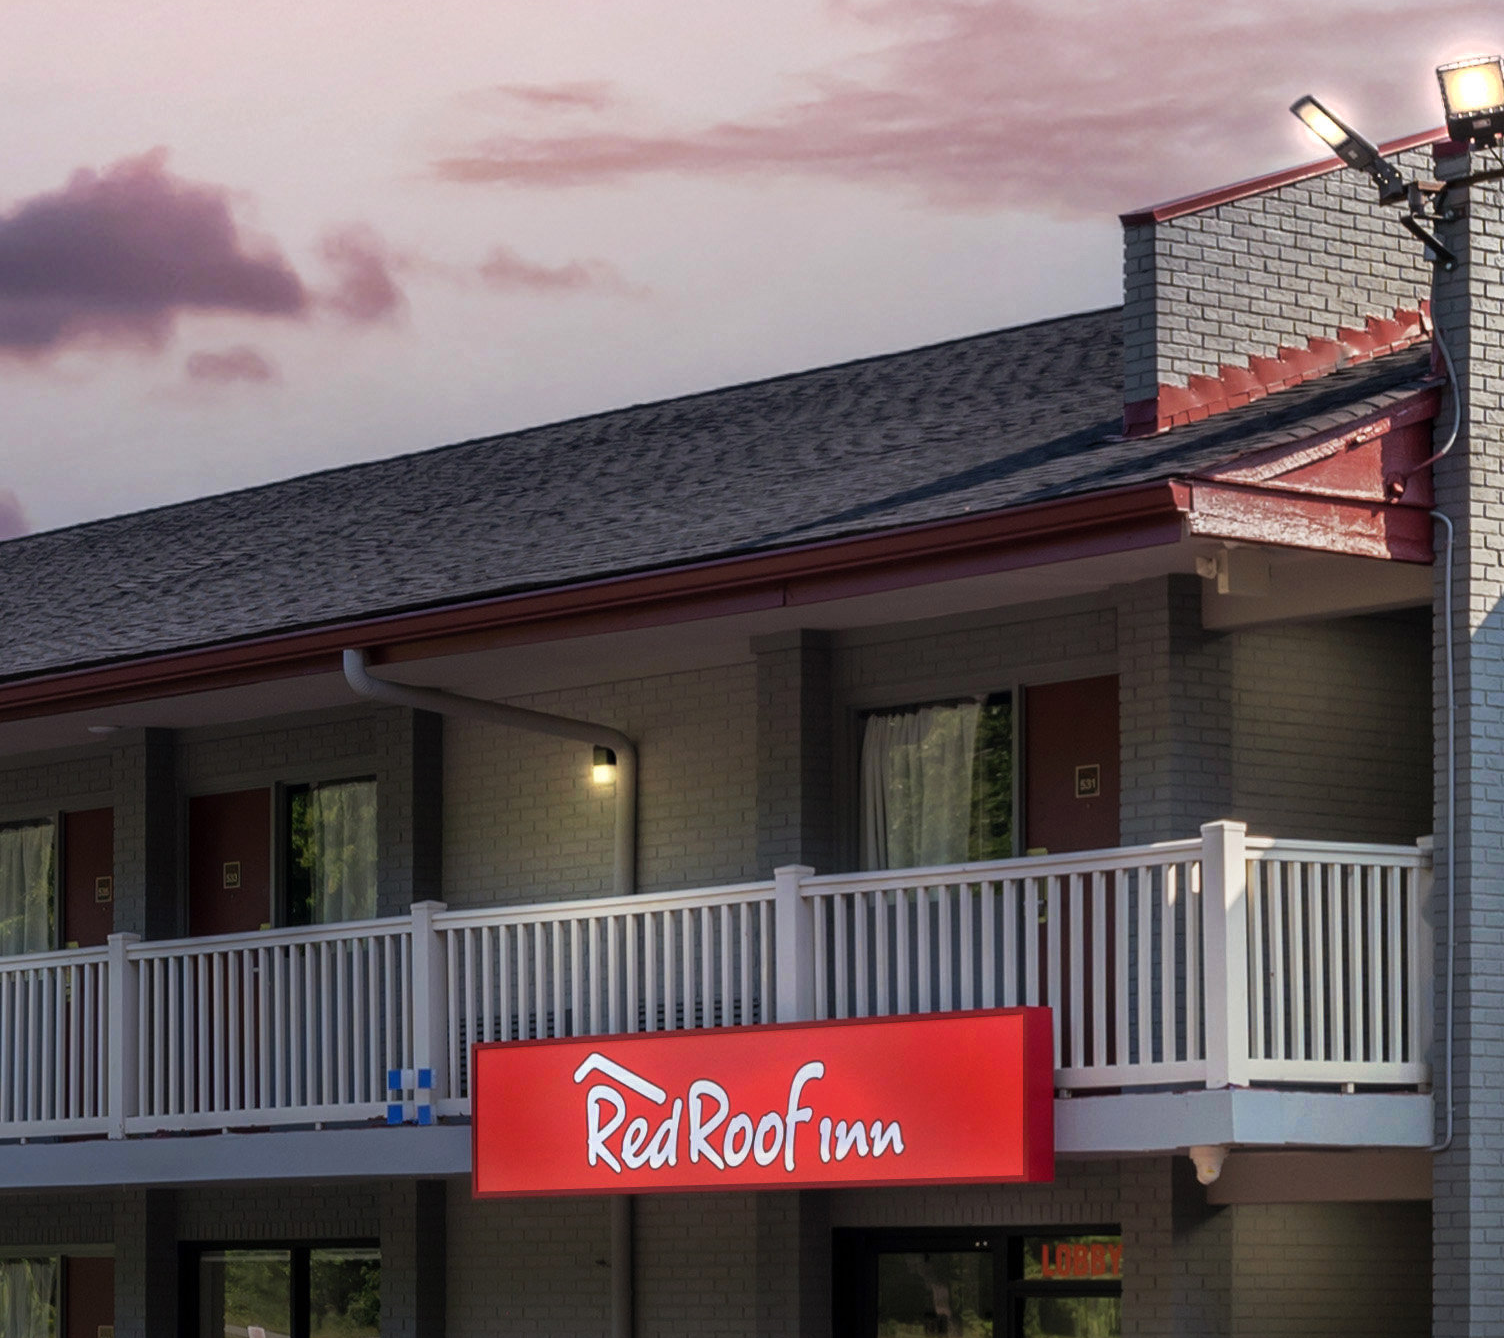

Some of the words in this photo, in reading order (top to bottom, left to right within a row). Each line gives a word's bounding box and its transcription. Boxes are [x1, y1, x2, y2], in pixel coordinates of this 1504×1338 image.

[587, 1084, 684, 1174] Red
[688, 1061, 826, 1173] Roof
[1041, 1242, 1123, 1278] LOBBY
